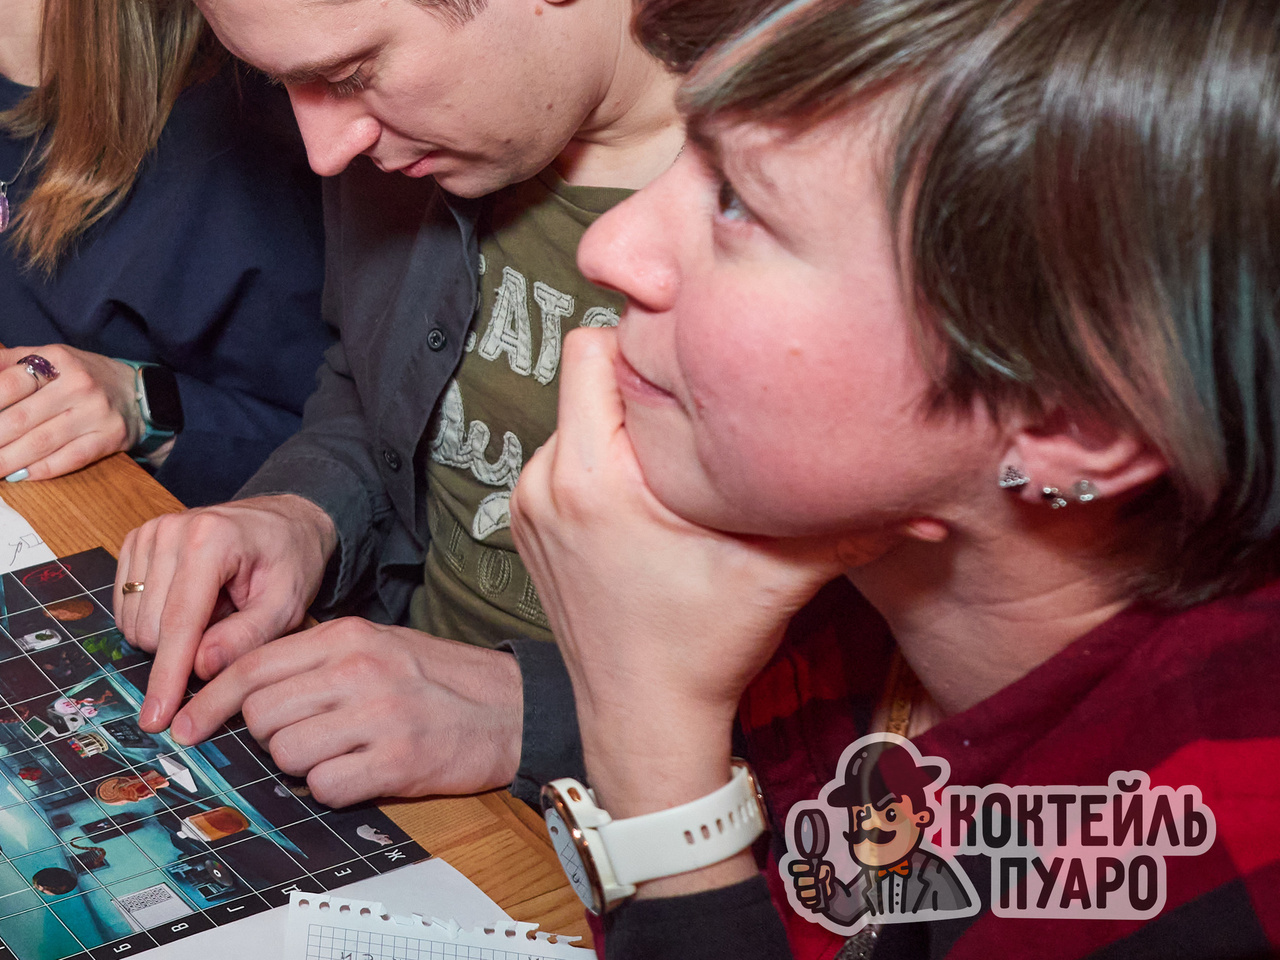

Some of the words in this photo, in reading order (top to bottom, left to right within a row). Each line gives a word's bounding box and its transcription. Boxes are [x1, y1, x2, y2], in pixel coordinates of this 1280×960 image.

[384, 848, 407, 862] Ж
[333, 867, 353, 878] Е
[226, 903, 245, 914] Г
[170, 921, 190, 934] В
[112, 942, 133, 954] Б
